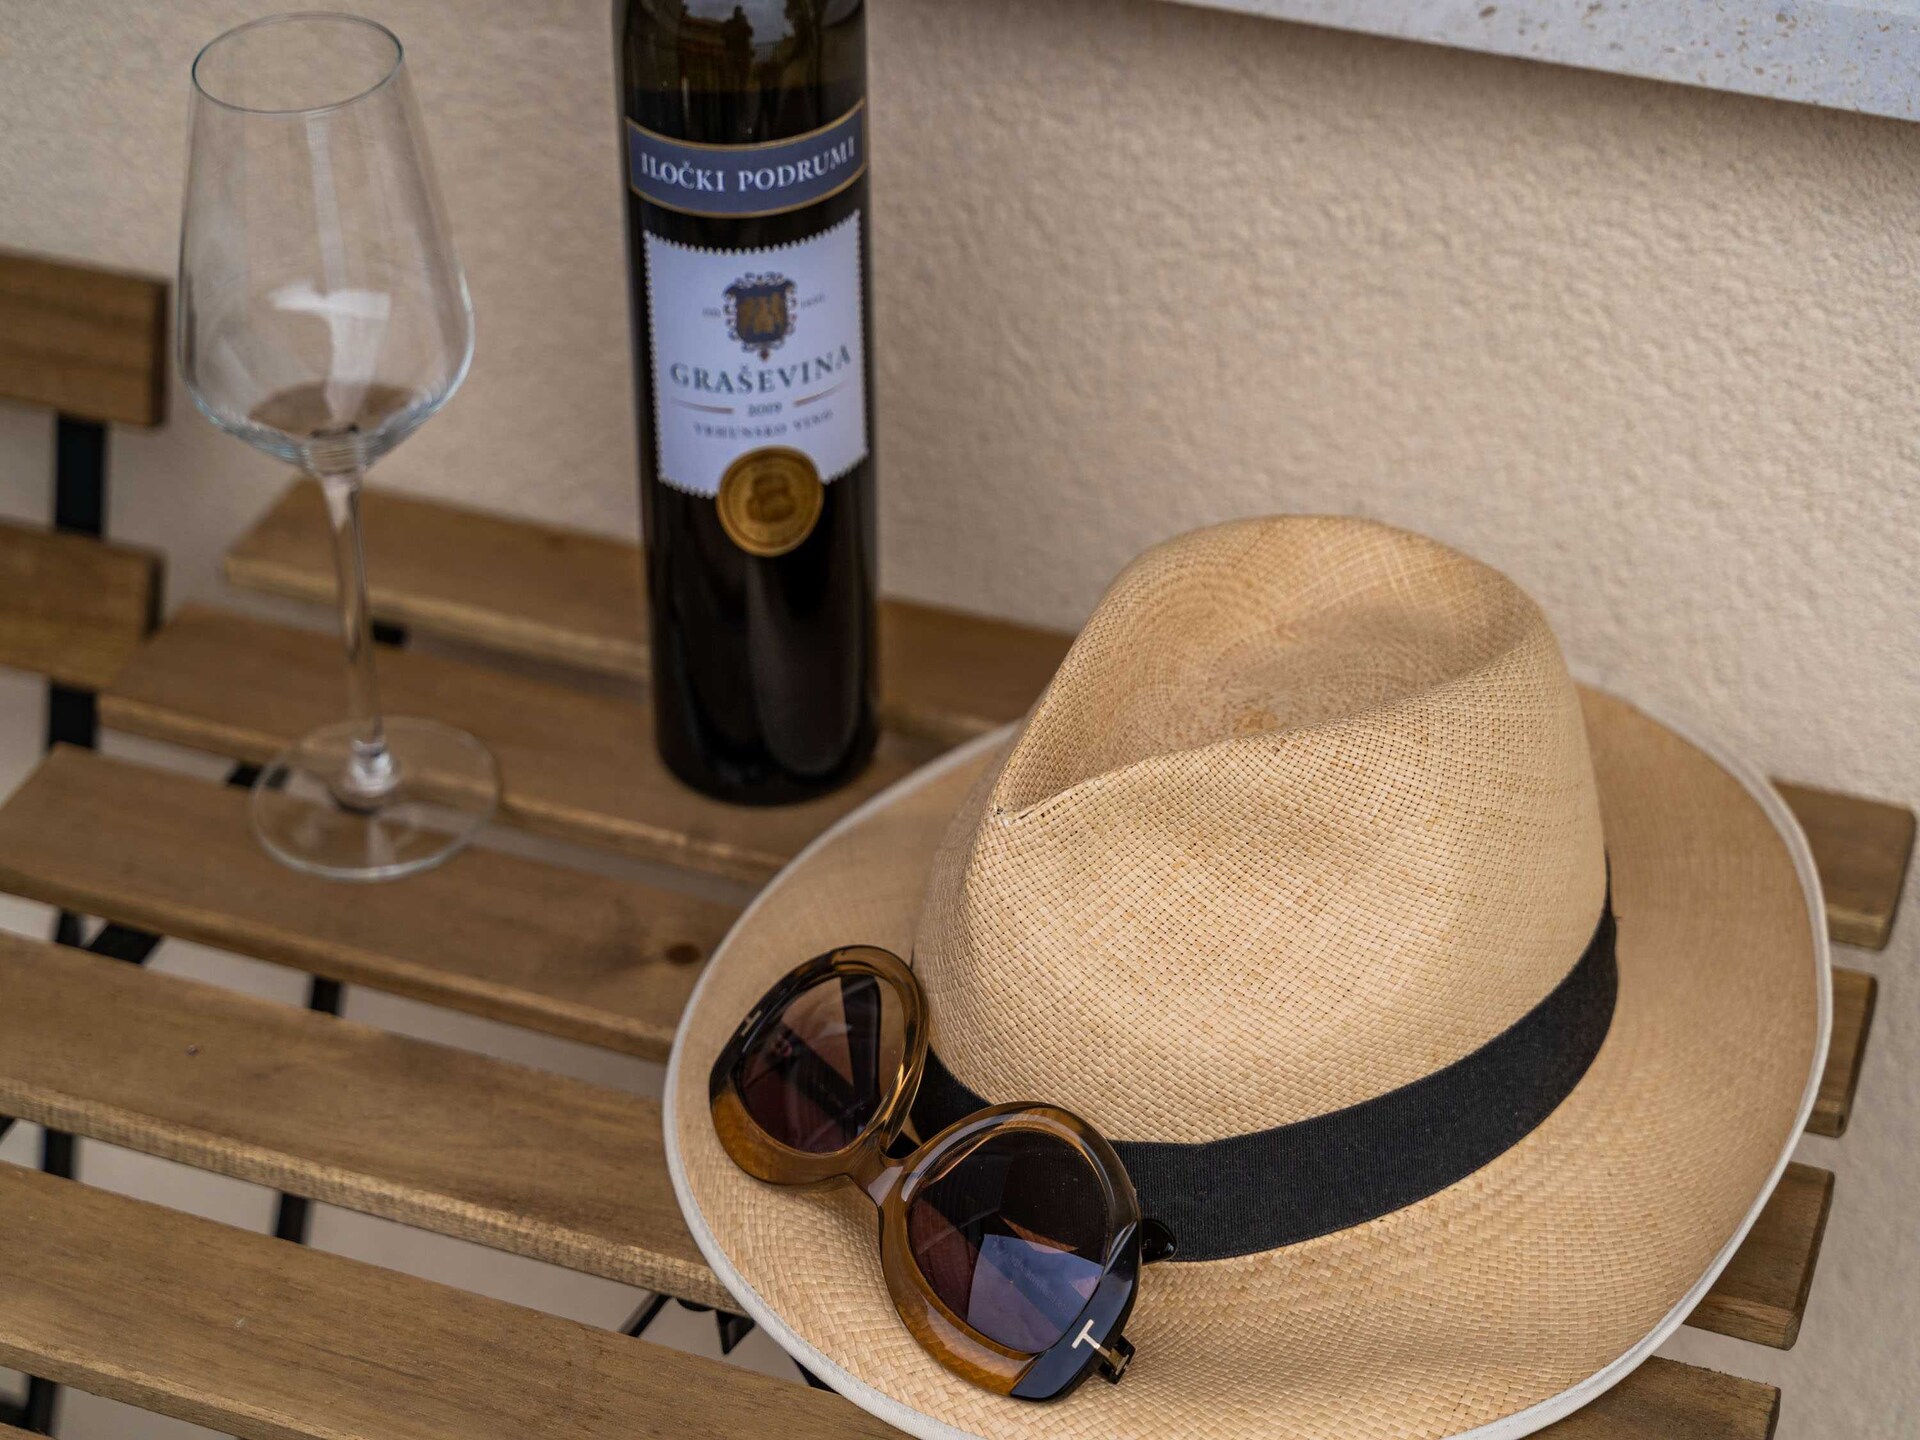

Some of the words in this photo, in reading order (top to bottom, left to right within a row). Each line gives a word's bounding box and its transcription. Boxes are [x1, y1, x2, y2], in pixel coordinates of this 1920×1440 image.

[641, 152, 725, 193] ILOČKI
[738, 135, 855, 192] PODRUMI
[670, 344, 851, 394] GRAŠEVINA
